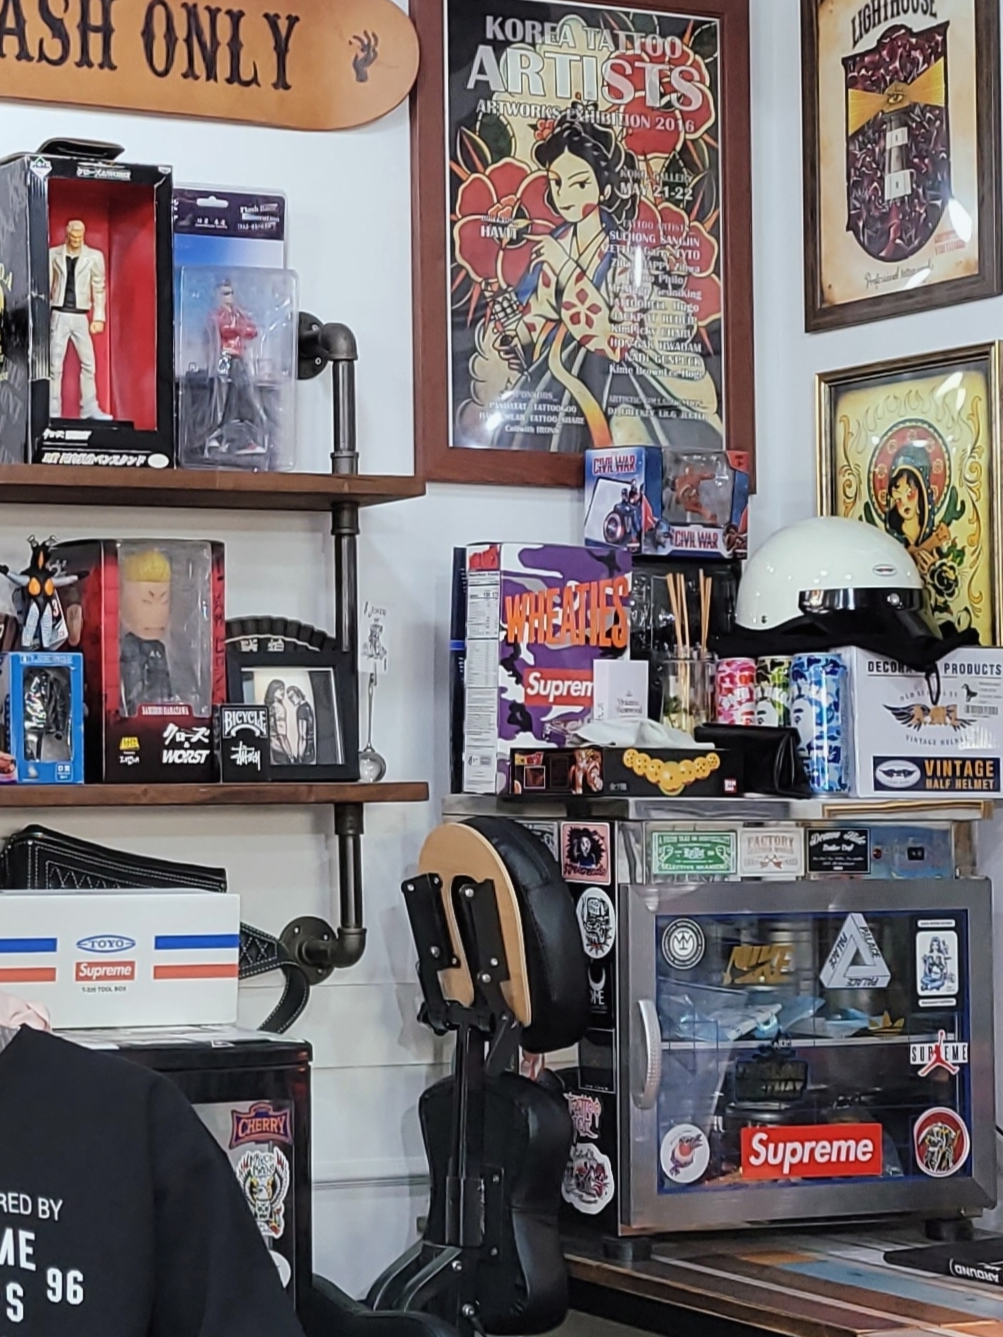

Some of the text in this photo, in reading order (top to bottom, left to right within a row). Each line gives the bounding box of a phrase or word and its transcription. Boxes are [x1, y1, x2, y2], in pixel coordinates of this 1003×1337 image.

[140, 1, 300, 91] ONLY
[486, 16, 683, 58] KOREA TATTOO
[467, 45, 702, 111] ARTISTS
[476, 99, 695, 133] ARTWORKS EXHIBITION 2016
[654, 185, 693, 200] 21-22
[593, 455, 636, 475] CIVIL WAR
[674, 530, 718, 549] CIVIL WAR
[505, 576, 629, 648] WHEATIES
[944, 663, 1002, 676] PRODUCTS
[526, 672, 594, 705] Suprem
[162, 722, 210, 745] クローズ
[224, 710, 268, 736] BICYCLE
[906, 734, 937, 746] VINTAGE
[162, 750, 210, 764] WORST
[924, 759, 994, 777] VINTAGE
[926, 779, 995, 790] HALF HELMET
[748, 835, 794, 848] FACTORY
[89, 940, 124, 948] TOYO
[829, 932, 847, 969] PALACE
[859, 926, 881, 958] PALACE
[79, 963, 132, 980] Supreme
[912, 1043, 967, 1062] SUPEME
[238, 1115, 286, 1137] CHERRY
[749, 1132, 873, 1175] Supreme
[38, 1197, 63, 1221] BY
[46, 1267, 84, 1305] 96
